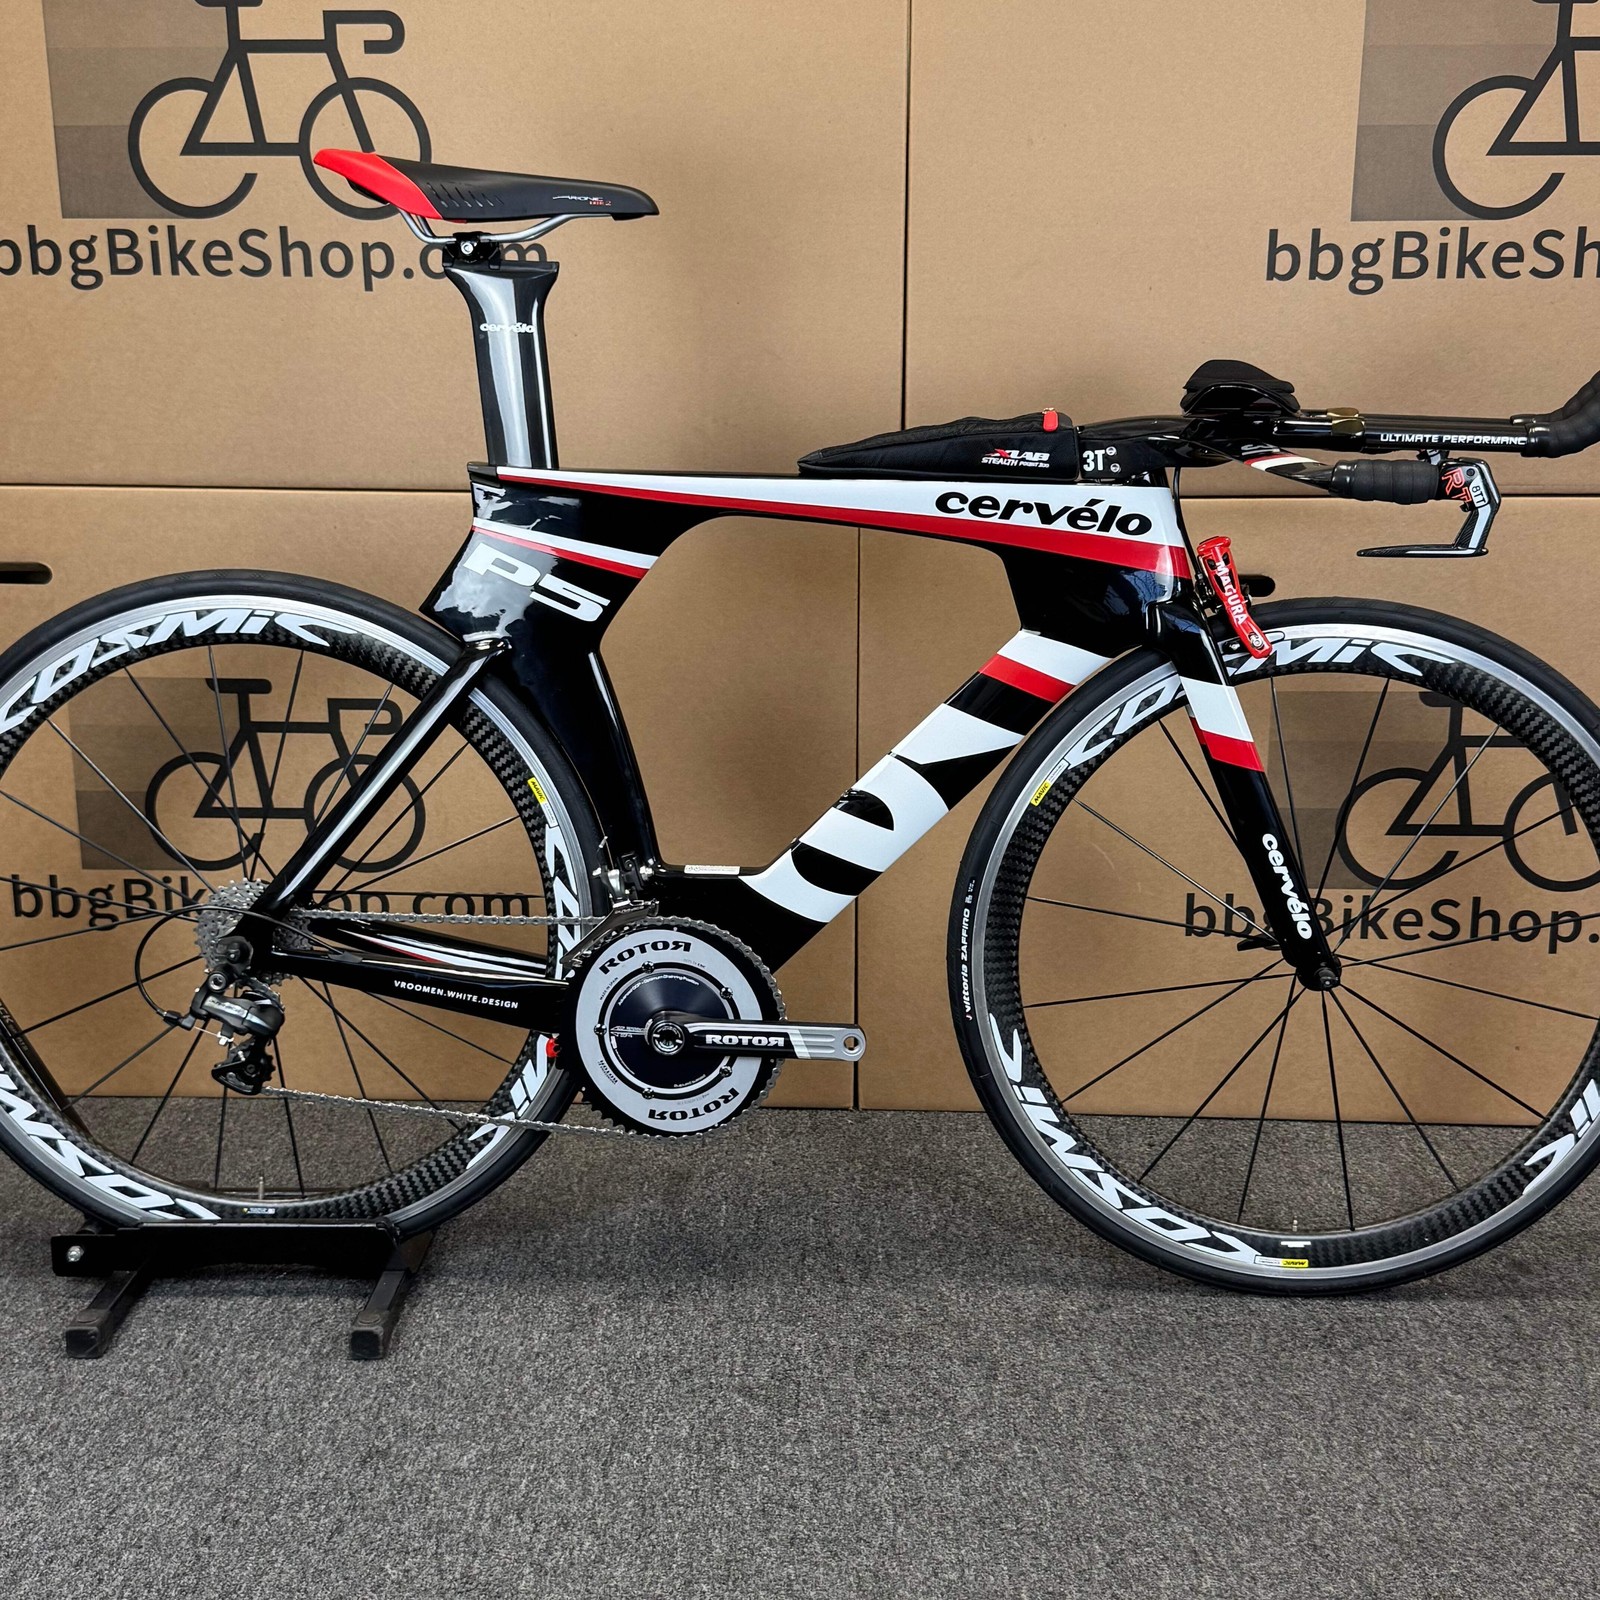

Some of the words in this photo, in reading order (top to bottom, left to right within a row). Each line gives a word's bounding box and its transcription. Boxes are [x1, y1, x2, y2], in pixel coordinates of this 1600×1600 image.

[1380, 433, 1438, 442] ULTIMATE
[981, 457, 1018, 466] STEALTH
[1083, 450, 1105, 471] 3T
[935, 491, 1152, 536] cervélo
[463, 542, 611, 622] P5
[1216, 560, 1248, 626] MAGURA
[1034, 782, 1049, 803] MAVIC
[1262, 833, 1313, 940] cervélo
[394, 980, 518, 1009] VROOMEN.WHITE.DESIGN
[705, 1034, 784, 1047] ROTOR
